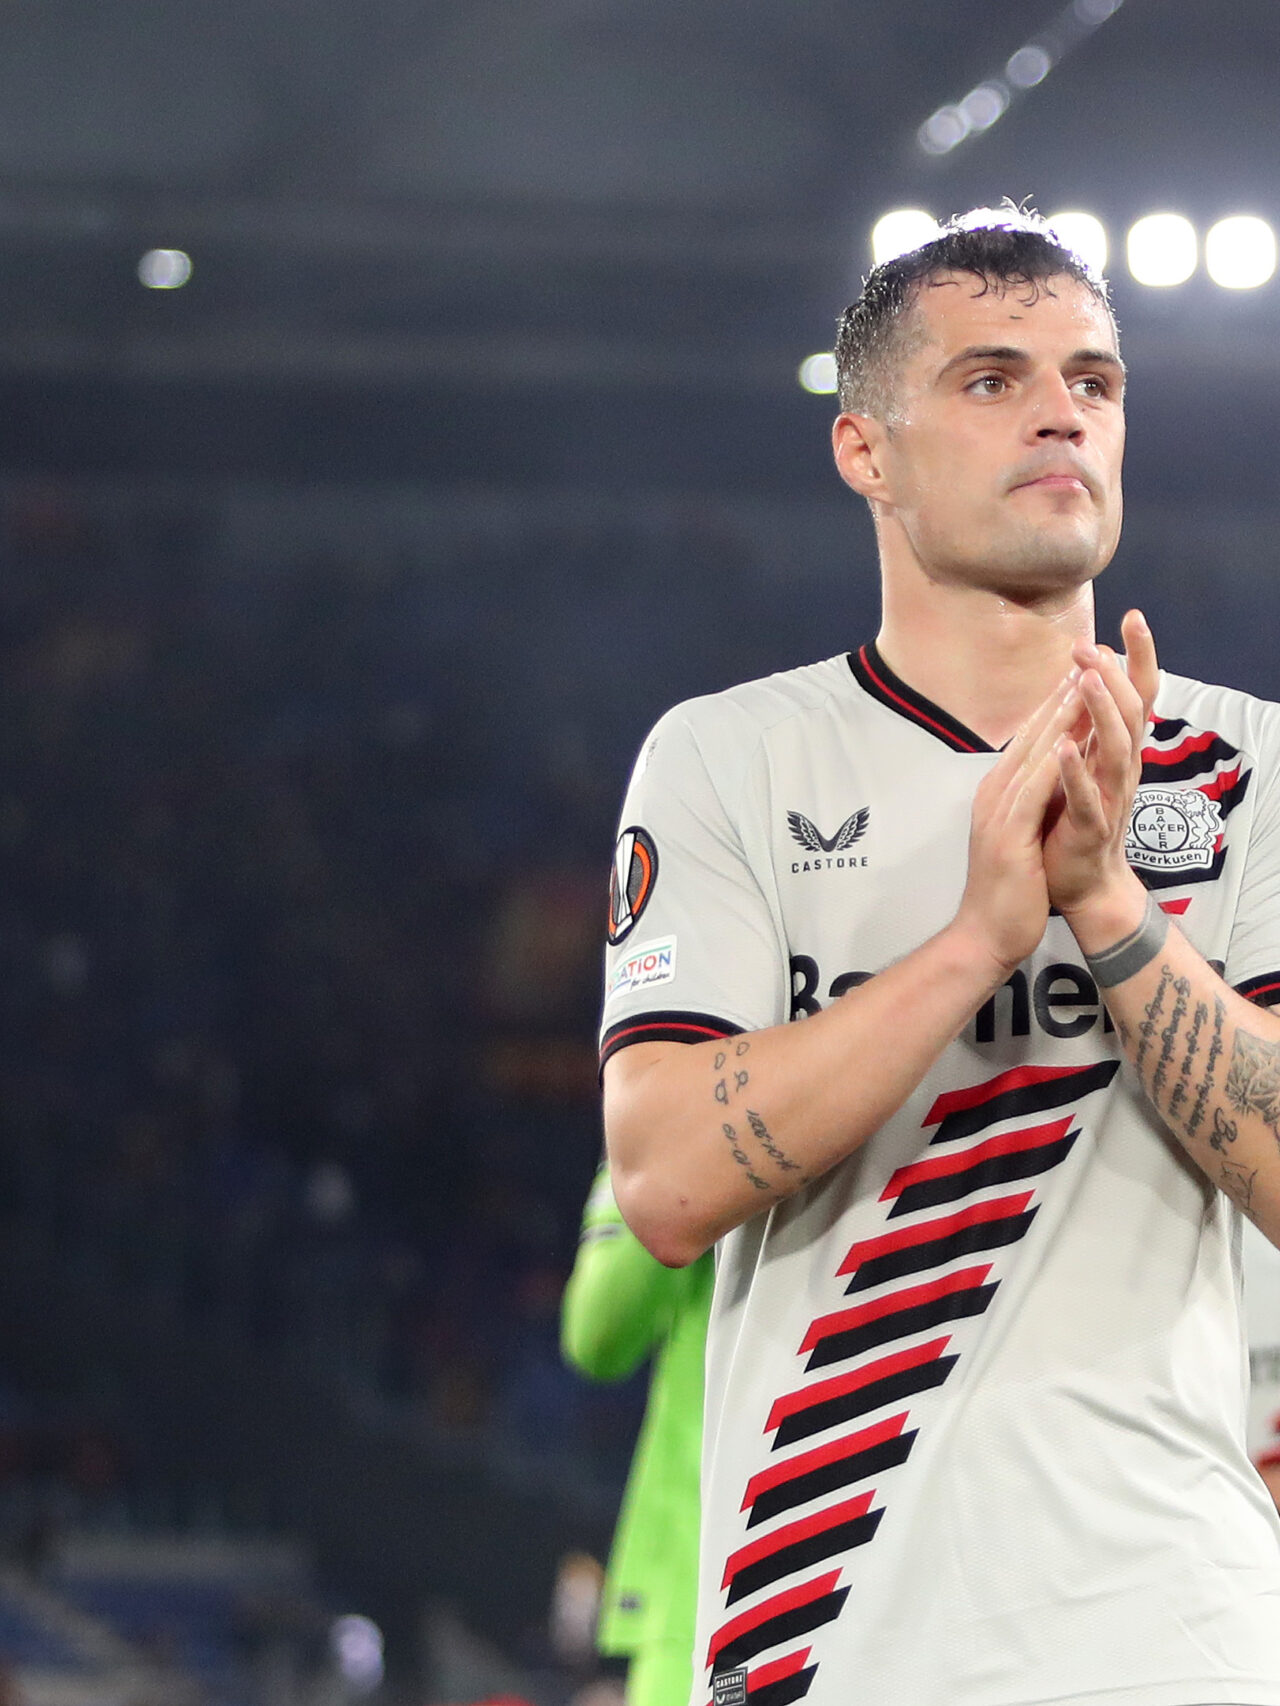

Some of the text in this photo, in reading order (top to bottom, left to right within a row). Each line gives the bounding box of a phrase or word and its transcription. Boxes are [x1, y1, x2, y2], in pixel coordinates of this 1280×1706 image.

[1144, 793, 1171, 803] 1904
[1138, 823, 1185, 832] BAYER
[1125, 849, 1202, 864] Leverkusen
[791, 856, 869, 873] CASTORE
